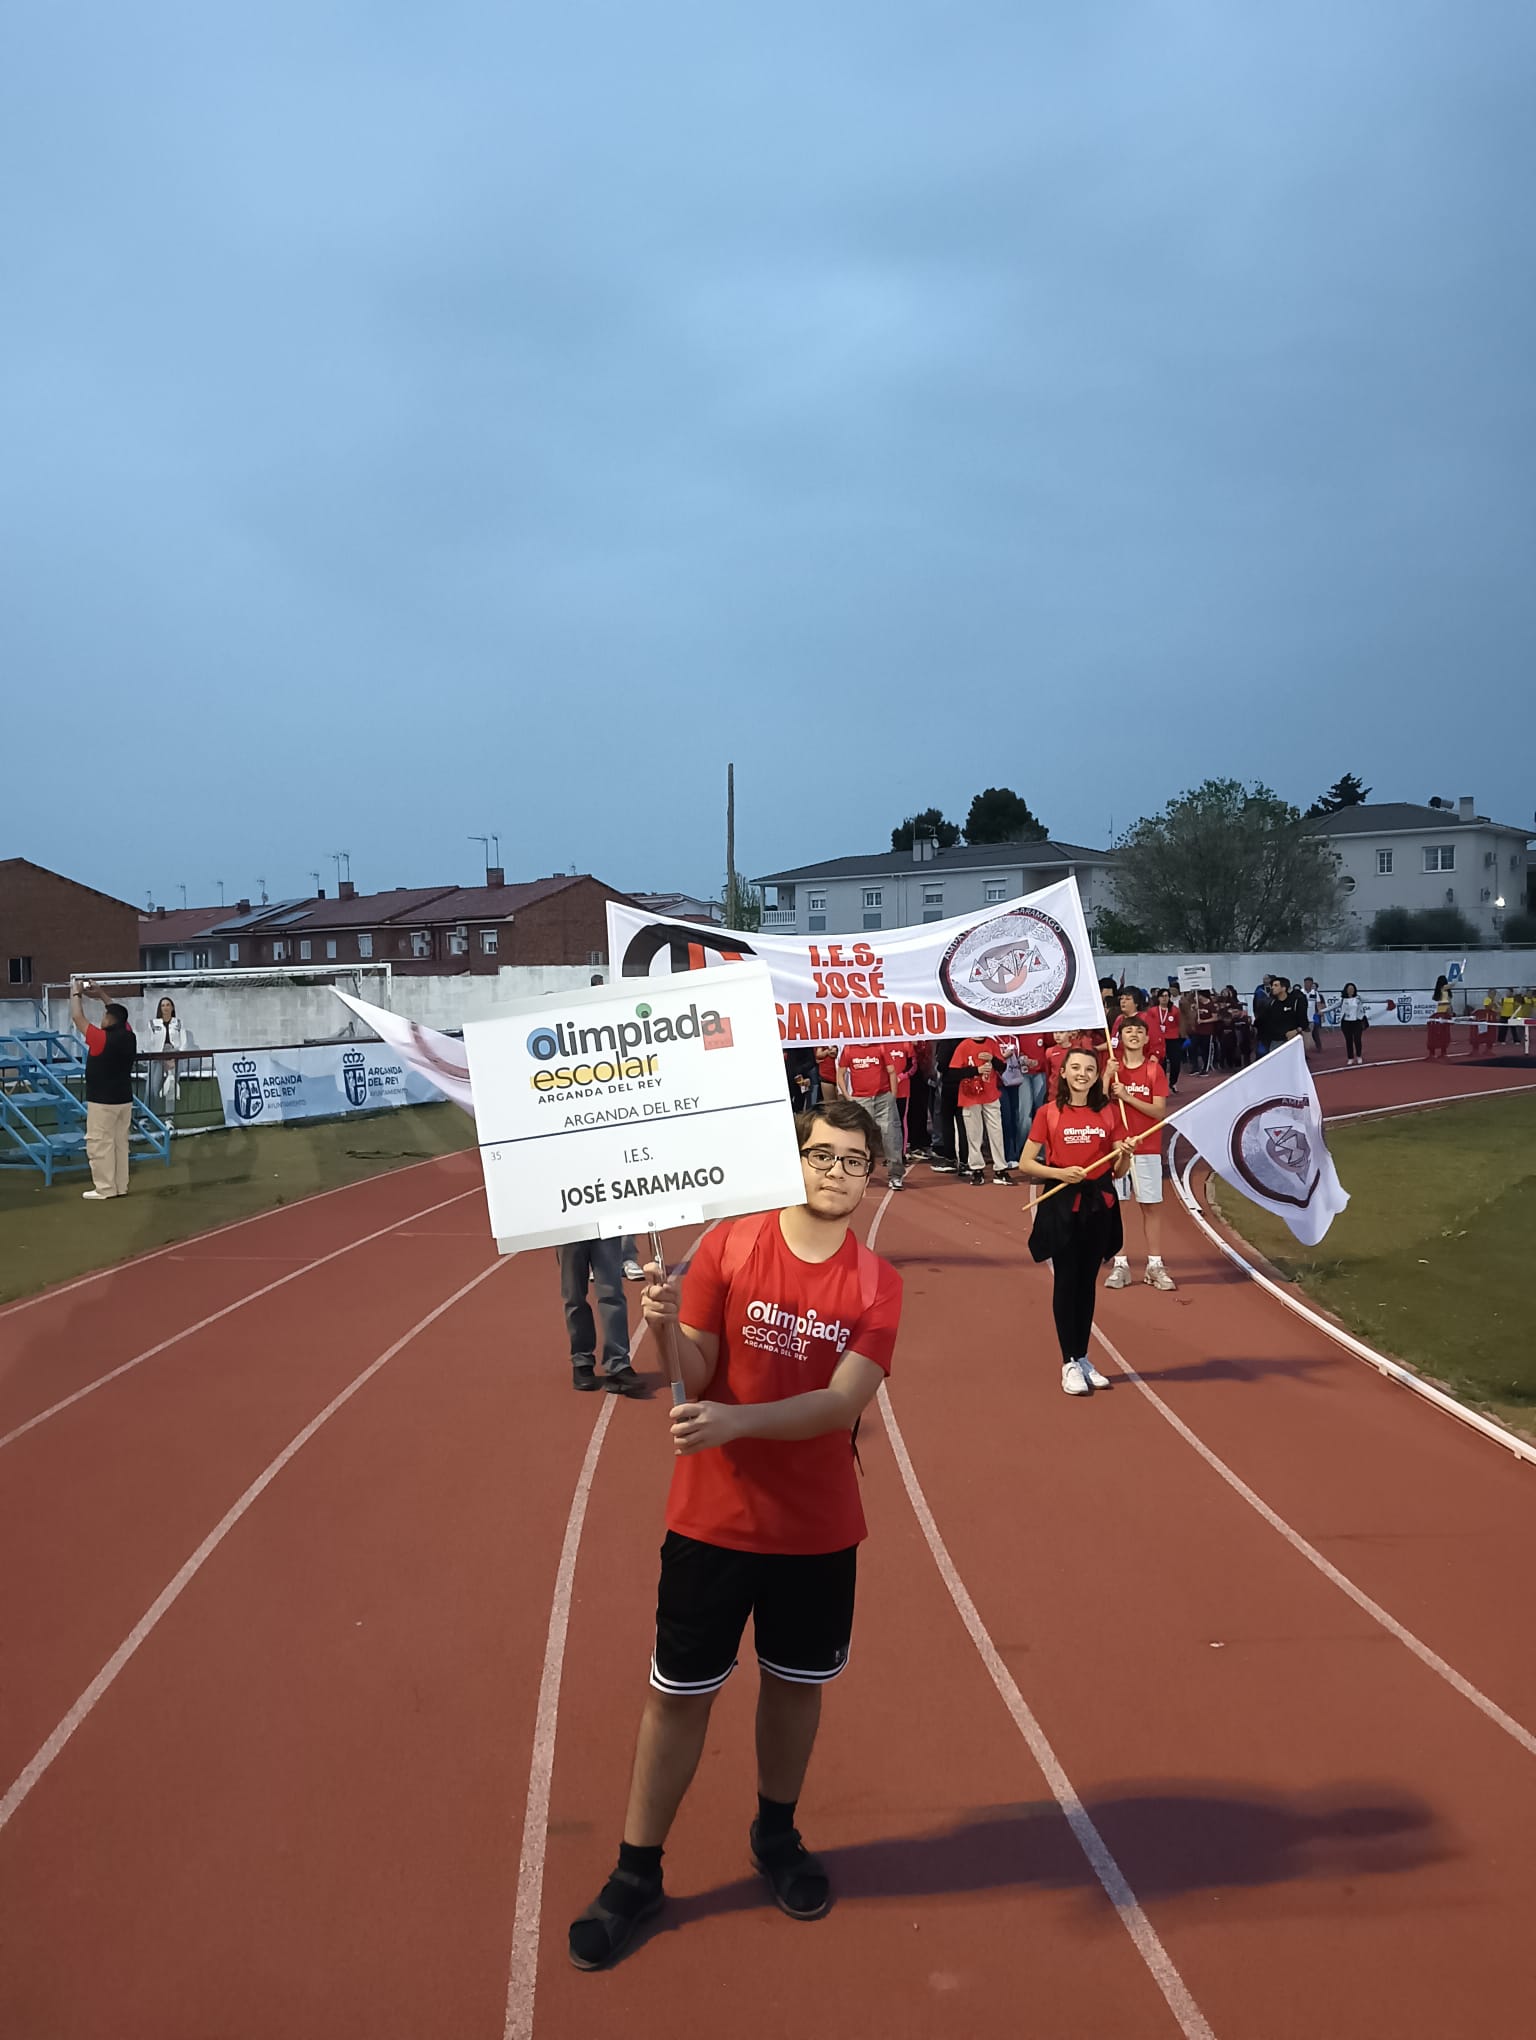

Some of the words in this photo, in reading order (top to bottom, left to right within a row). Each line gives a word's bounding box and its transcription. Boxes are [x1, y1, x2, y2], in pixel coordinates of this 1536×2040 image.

[809, 943, 883, 967] I.E.S.
[813, 966, 888, 999] JOSÉ
[530, 1003, 726, 1061] olimpiada
[263, 1074, 303, 1087] ARGANDA
[368, 1066, 403, 1076] ARGANDA
[368, 1077, 384, 1087] DEL
[385, 1076, 399, 1085] REY
[533, 1050, 659, 1092] escolar
[264, 1089, 282, 1099] DEL
[283, 1087, 296, 1096] REY
[538, 1087, 603, 1105] ARGANDA
[608, 1083, 633, 1094] DEL
[639, 1078, 662, 1089] REY
[564, 1106, 640, 1129] ARGANDA
[643, 1102, 671, 1116] DEL
[675, 1096, 701, 1112] REY
[490, 1152, 502, 1161] 35
[624, 1147, 654, 1164] I.E.S.
[560, 1178, 607, 1213] JOSÉ
[611, 1166, 725, 1200] SARAMAGO
[744, 1339, 779, 1353] ARGANDA
[780, 1349, 792, 1358] DEL
[794, 1353, 808, 1361] REY
[745, 1325, 811, 1354] escolar
